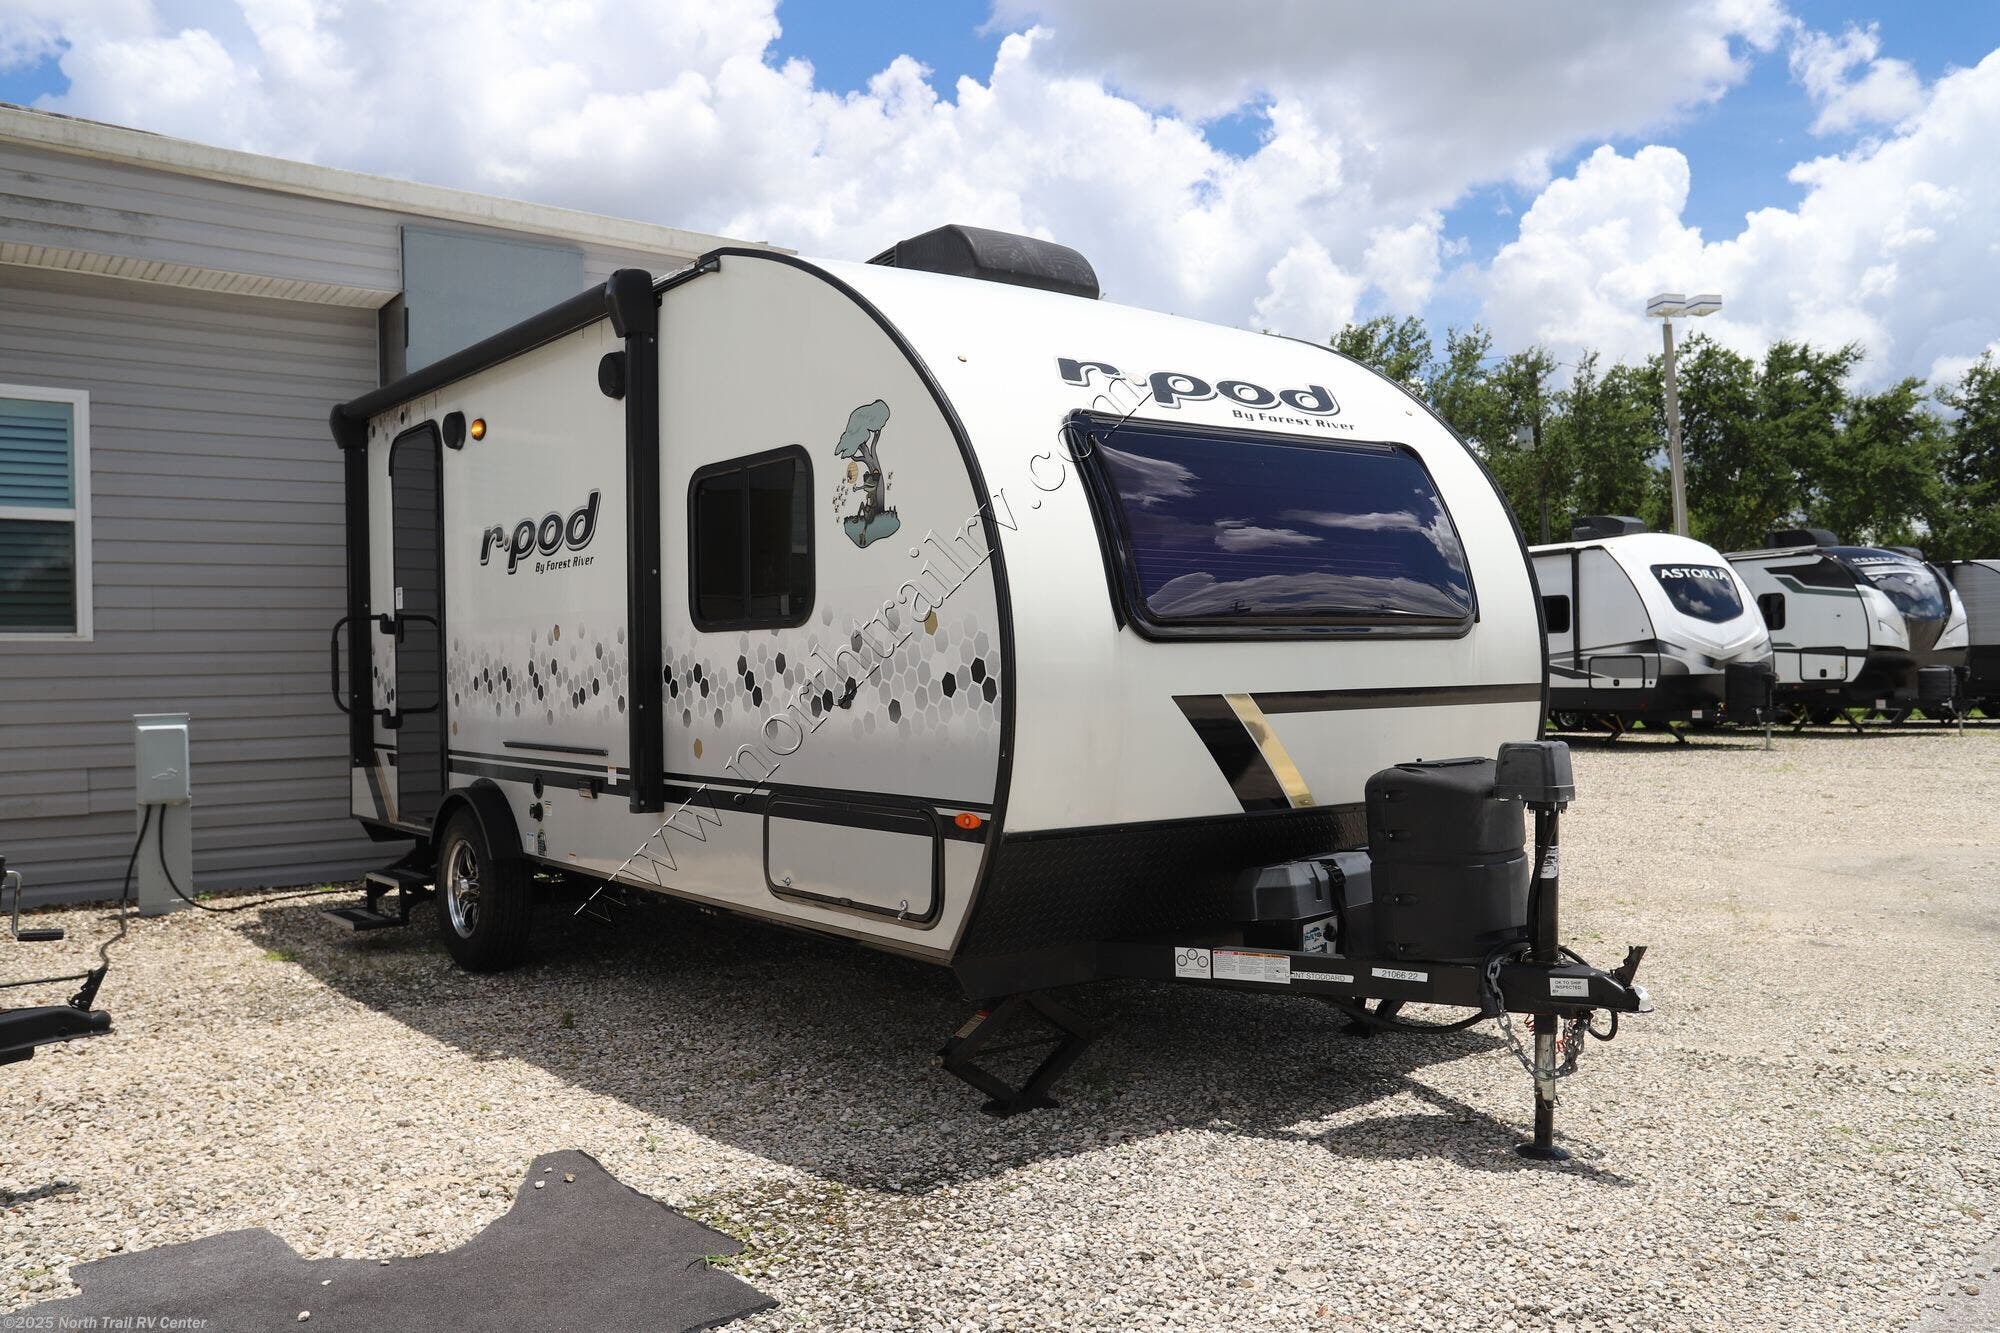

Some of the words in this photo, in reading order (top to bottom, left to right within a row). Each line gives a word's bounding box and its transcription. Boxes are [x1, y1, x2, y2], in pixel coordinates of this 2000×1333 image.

[1231, 409, 1255, 422] By
[1258, 412, 1313, 427] Forest
[1316, 418, 1355, 431] River
[535, 561, 545, 574] By
[546, 559, 571, 571] Forest
[572, 556, 594, 567] River
[1661, 567, 1728, 580] ASTORIA
[1408, 972, 1418, 980] 22
